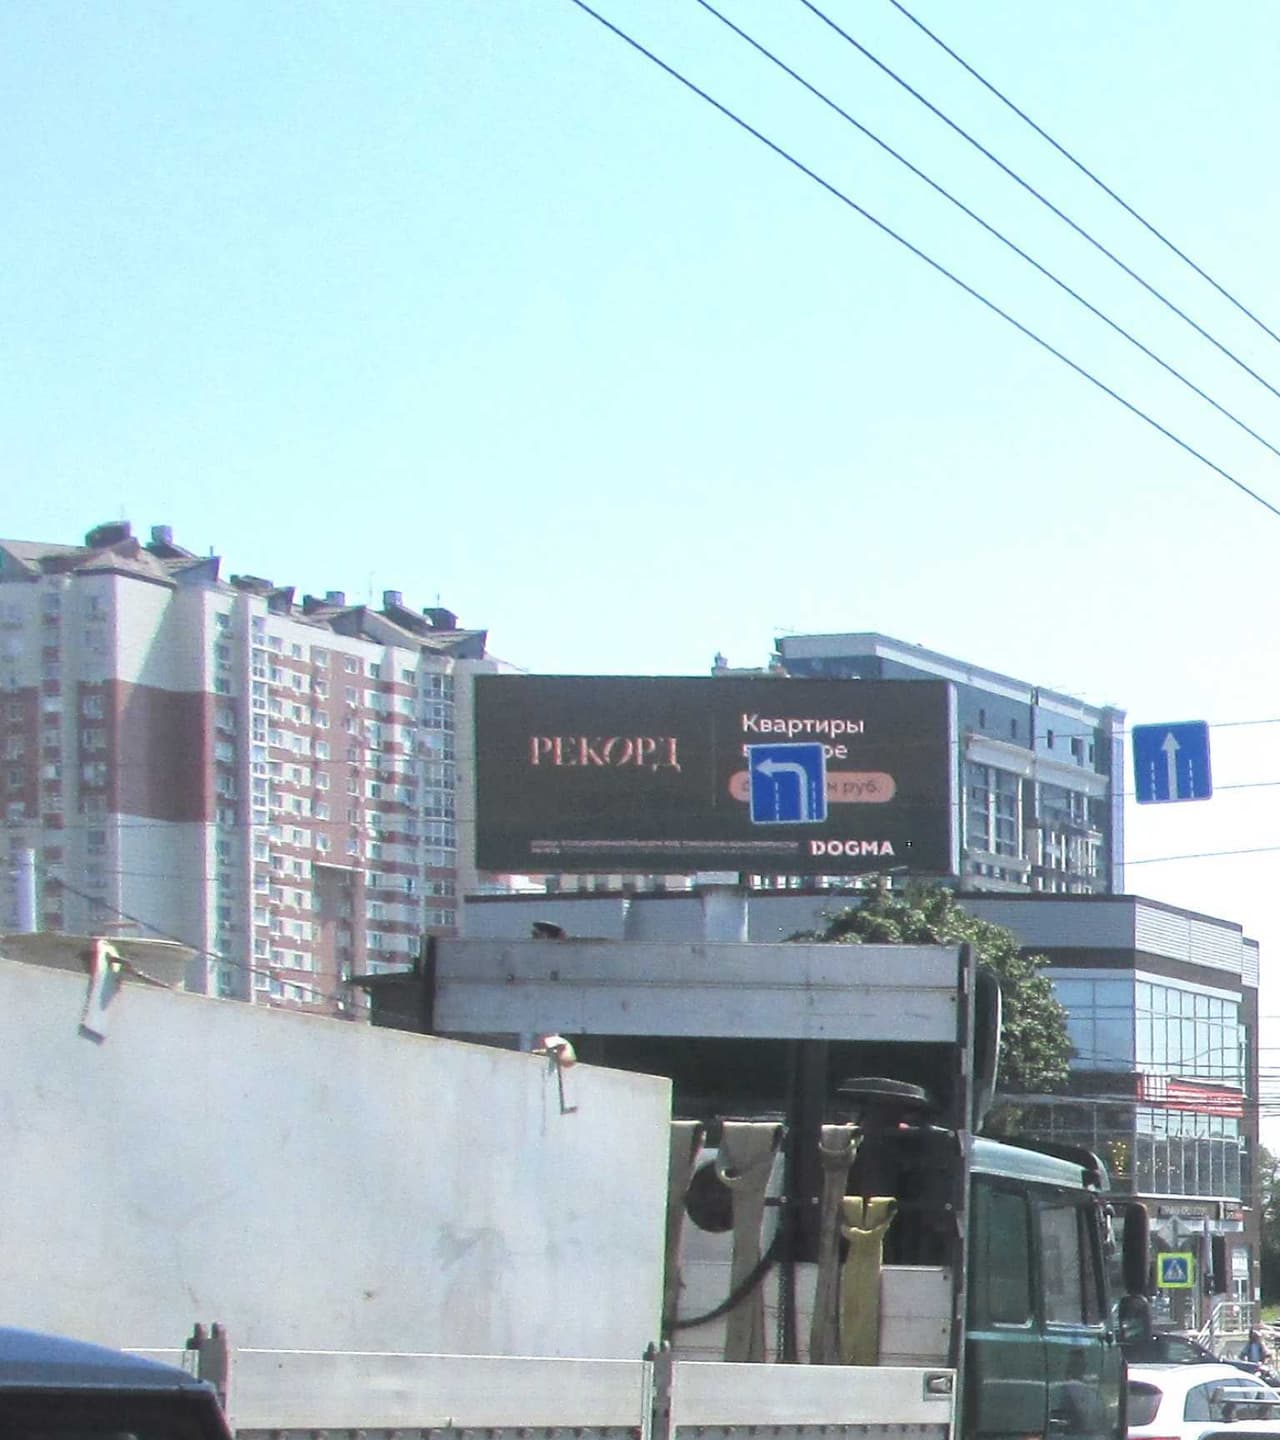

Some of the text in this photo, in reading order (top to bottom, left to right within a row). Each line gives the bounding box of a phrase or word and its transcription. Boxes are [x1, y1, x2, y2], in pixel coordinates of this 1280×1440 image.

[742, 713, 865, 739] Квартиры
[528, 735, 682, 772] РЕКОРД
[810, 840, 895, 856] DOGMA
